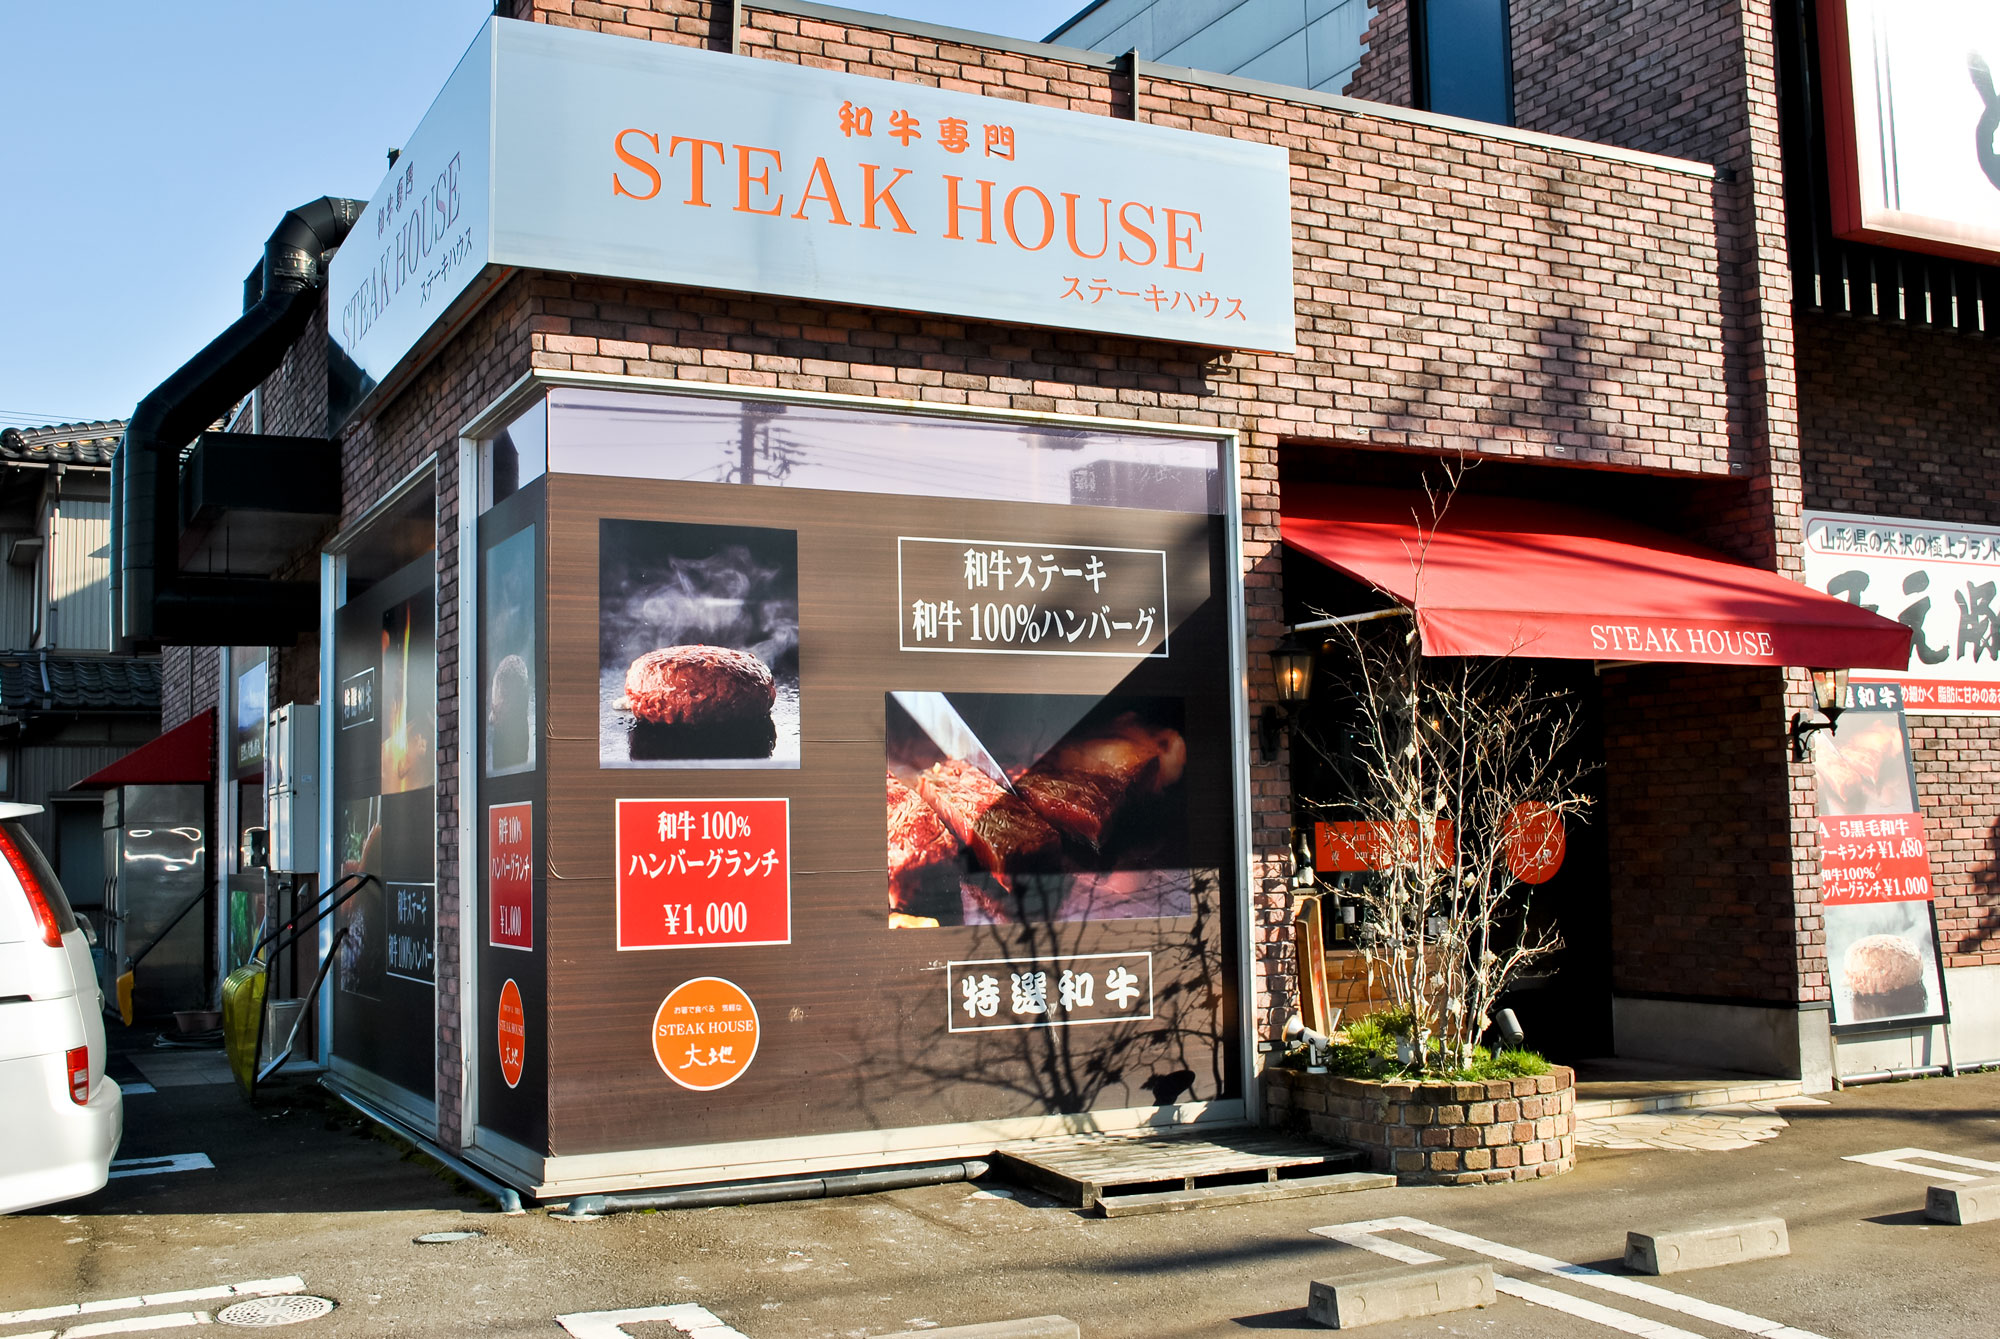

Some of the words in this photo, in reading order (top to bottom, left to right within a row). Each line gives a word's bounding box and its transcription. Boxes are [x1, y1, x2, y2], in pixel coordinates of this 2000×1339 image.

[838, 100, 1015, 161] 和牛専門
[613, 128, 917, 234] STEAK
[943, 175, 1205, 273] HOUSE
[342, 246, 392, 357] STEAK
[395, 152, 461, 295] HOUSE
[420, 227, 473, 308] ステーキハウス
[1060, 276, 1247, 321] ステーキハウス
[963, 548, 1107, 594] 和牛ステーキ
[1590, 624, 1683, 653] STEAK
[1686, 629, 1774, 657] HOUSE
[628, 847, 780, 879] ハンバーグランチ
[1877, 838, 1923, 859] ¥1,480
[1882, 876, 1928, 896] ¥1,000
[663, 901, 748, 936] ¥1,000
[961, 966, 1141, 1018] 特選和牛
[659, 1022, 705, 1036] STEAK
[708, 1020, 754, 1034] HOUSE
[679, 1043, 736, 1069] 大地
